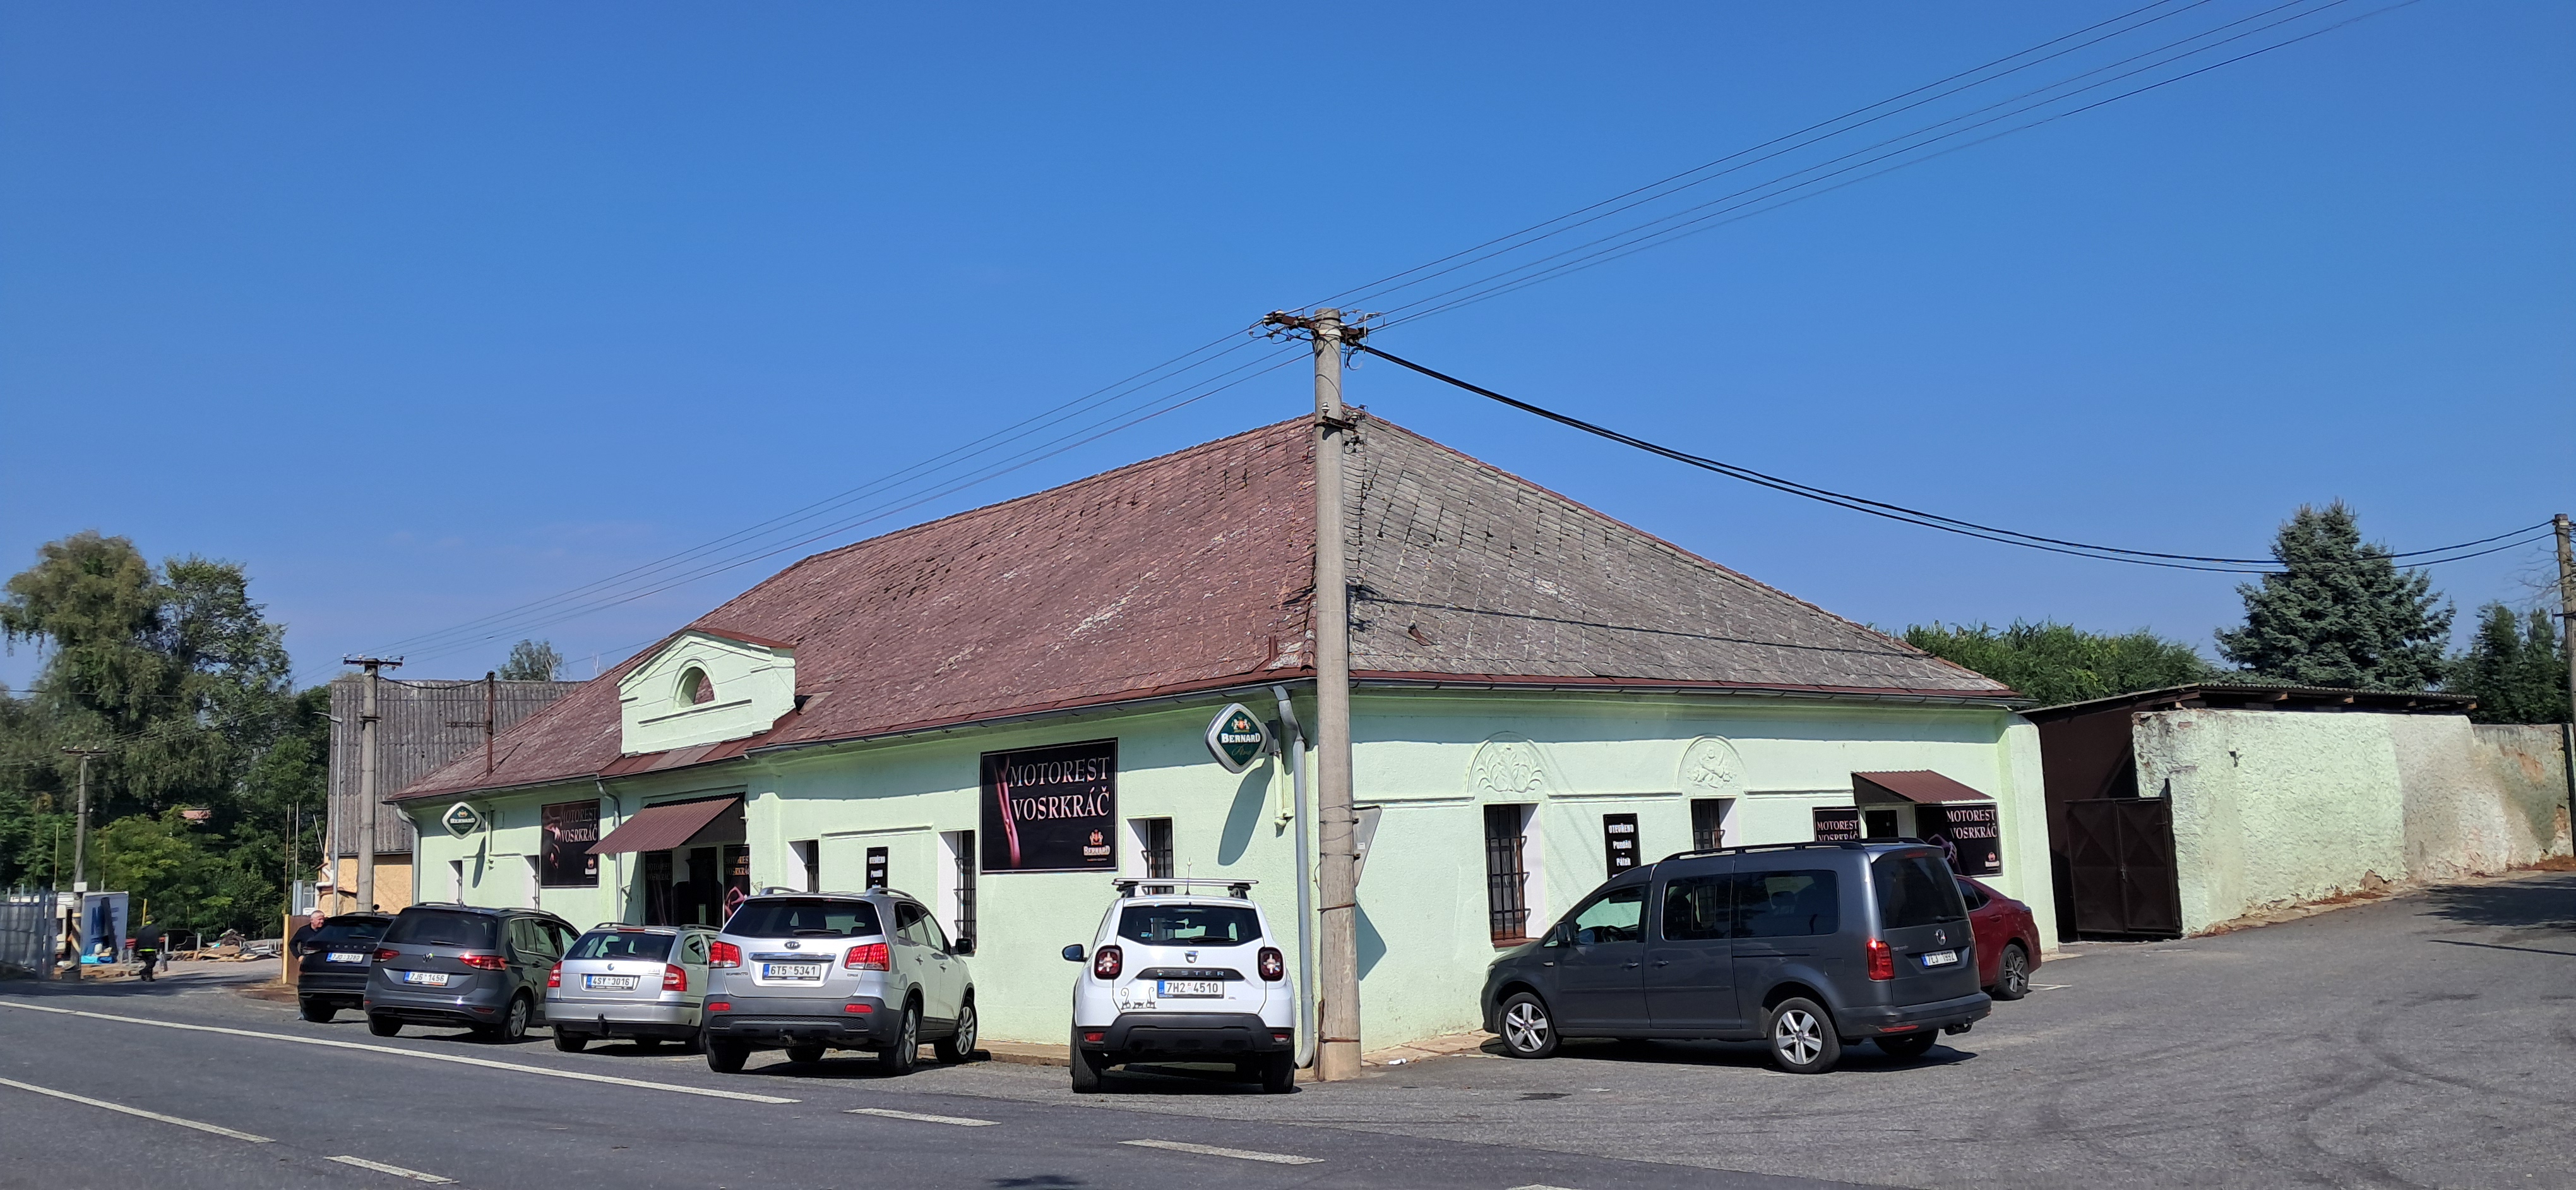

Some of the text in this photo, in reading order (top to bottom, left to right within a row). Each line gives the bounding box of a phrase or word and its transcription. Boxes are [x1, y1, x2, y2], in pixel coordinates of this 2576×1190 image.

[1221, 733, 1261, 743] BERNARD
[1008, 756, 1110, 788] MOTOREST
[1011, 786, 1110, 821] VOSRKRÁČ
[1946, 809, 1995, 822] MOTOREST
[1816, 820, 1858, 831] MOTOREST
[1950, 822, 1998, 839] VOSRKRÁČ
[561, 823, 597, 843] VOSRKRÁČ
[1083, 845, 1111, 856] BERNARD
[771, 966, 816, 975] 6T5 5341
[1166, 982, 1219, 993] 7H2 4510
